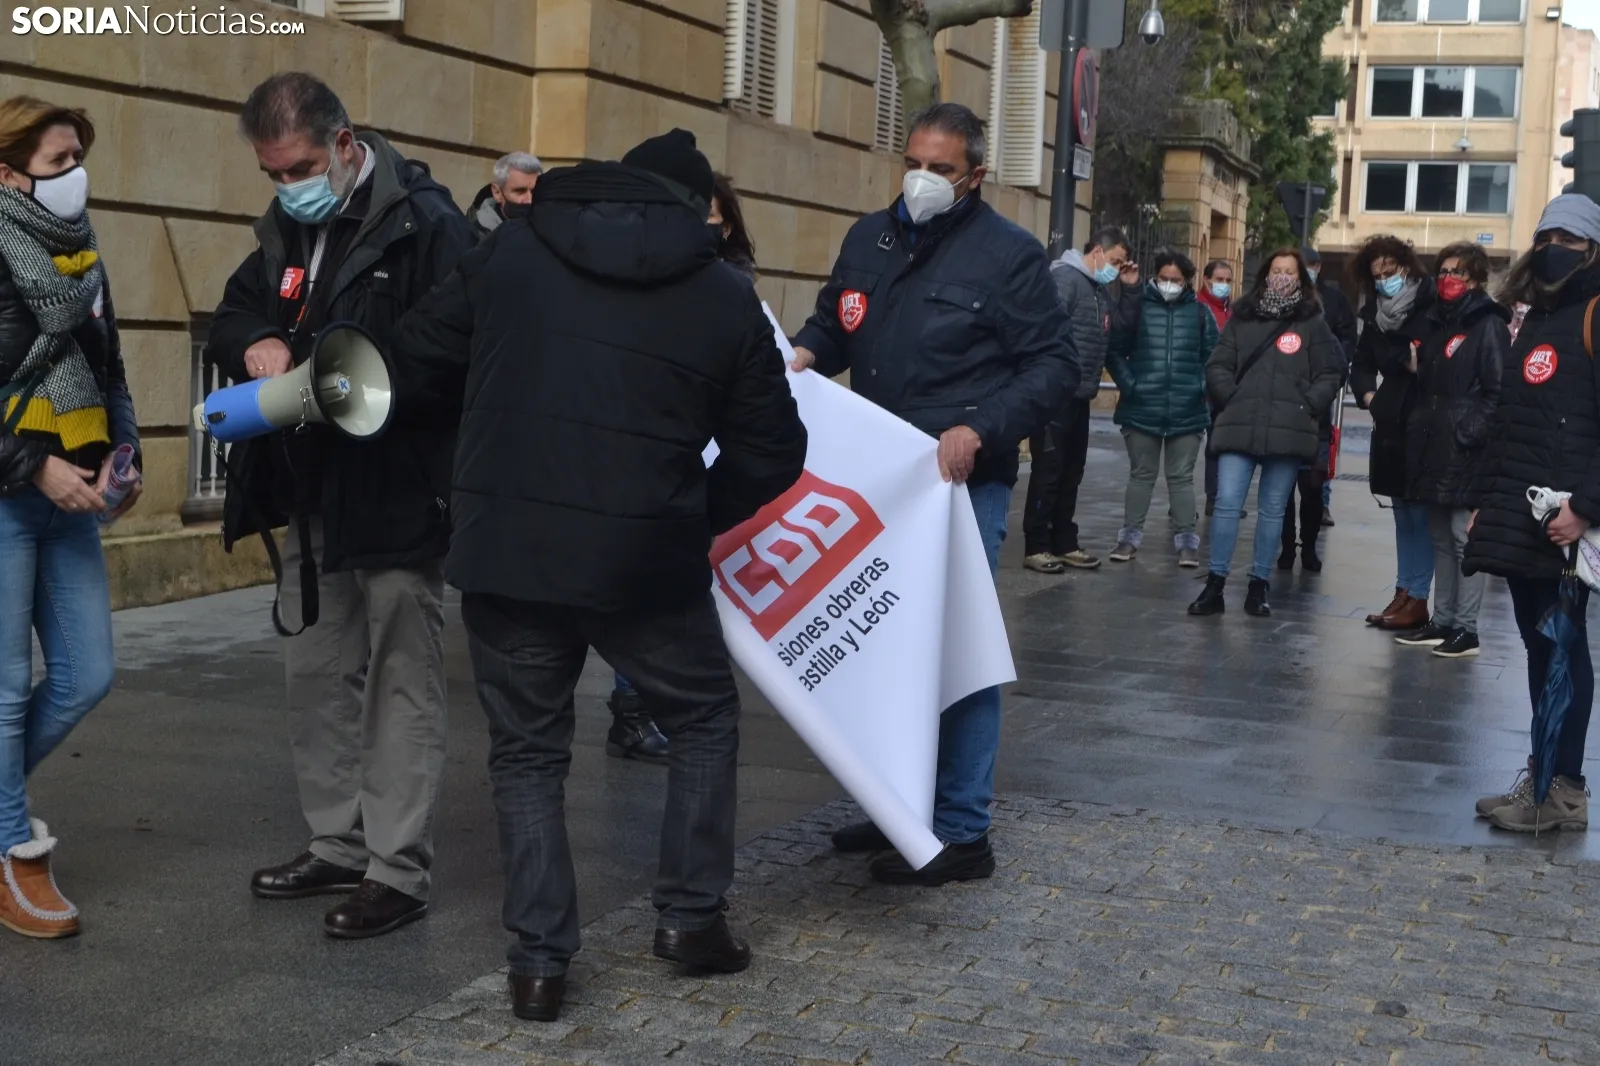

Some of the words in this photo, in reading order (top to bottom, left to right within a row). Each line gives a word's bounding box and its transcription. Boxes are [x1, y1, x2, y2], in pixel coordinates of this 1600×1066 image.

[1530, 350, 1552, 364] UGT
[777, 615, 830, 668] siones
[826, 557, 890, 619] obreras
[848, 588, 901, 636] León
[839, 630, 860, 653] y
